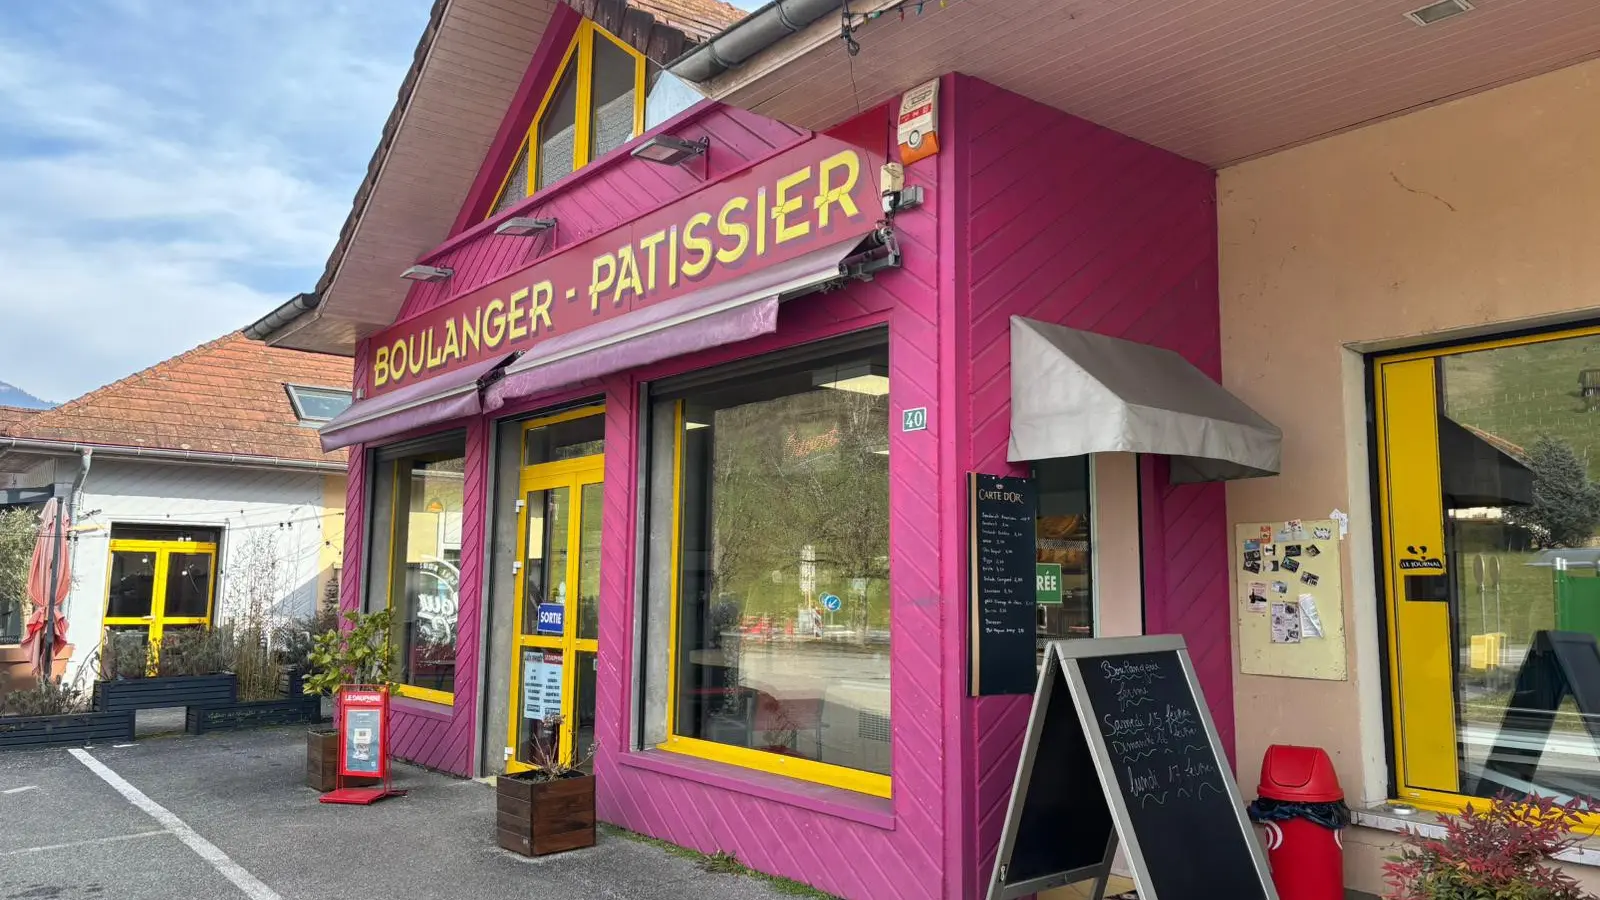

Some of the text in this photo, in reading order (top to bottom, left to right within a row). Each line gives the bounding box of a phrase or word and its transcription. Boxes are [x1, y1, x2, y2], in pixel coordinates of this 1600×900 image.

[373, 279, 554, 387] BOULANGER
[587, 148, 863, 312] PATISSIER
[906, 410, 923, 428] 40
[979, 488, 1001, 501] CARTE
[1036, 570, 1057, 592] RÉE
[540, 611, 562, 625] SORTIE
